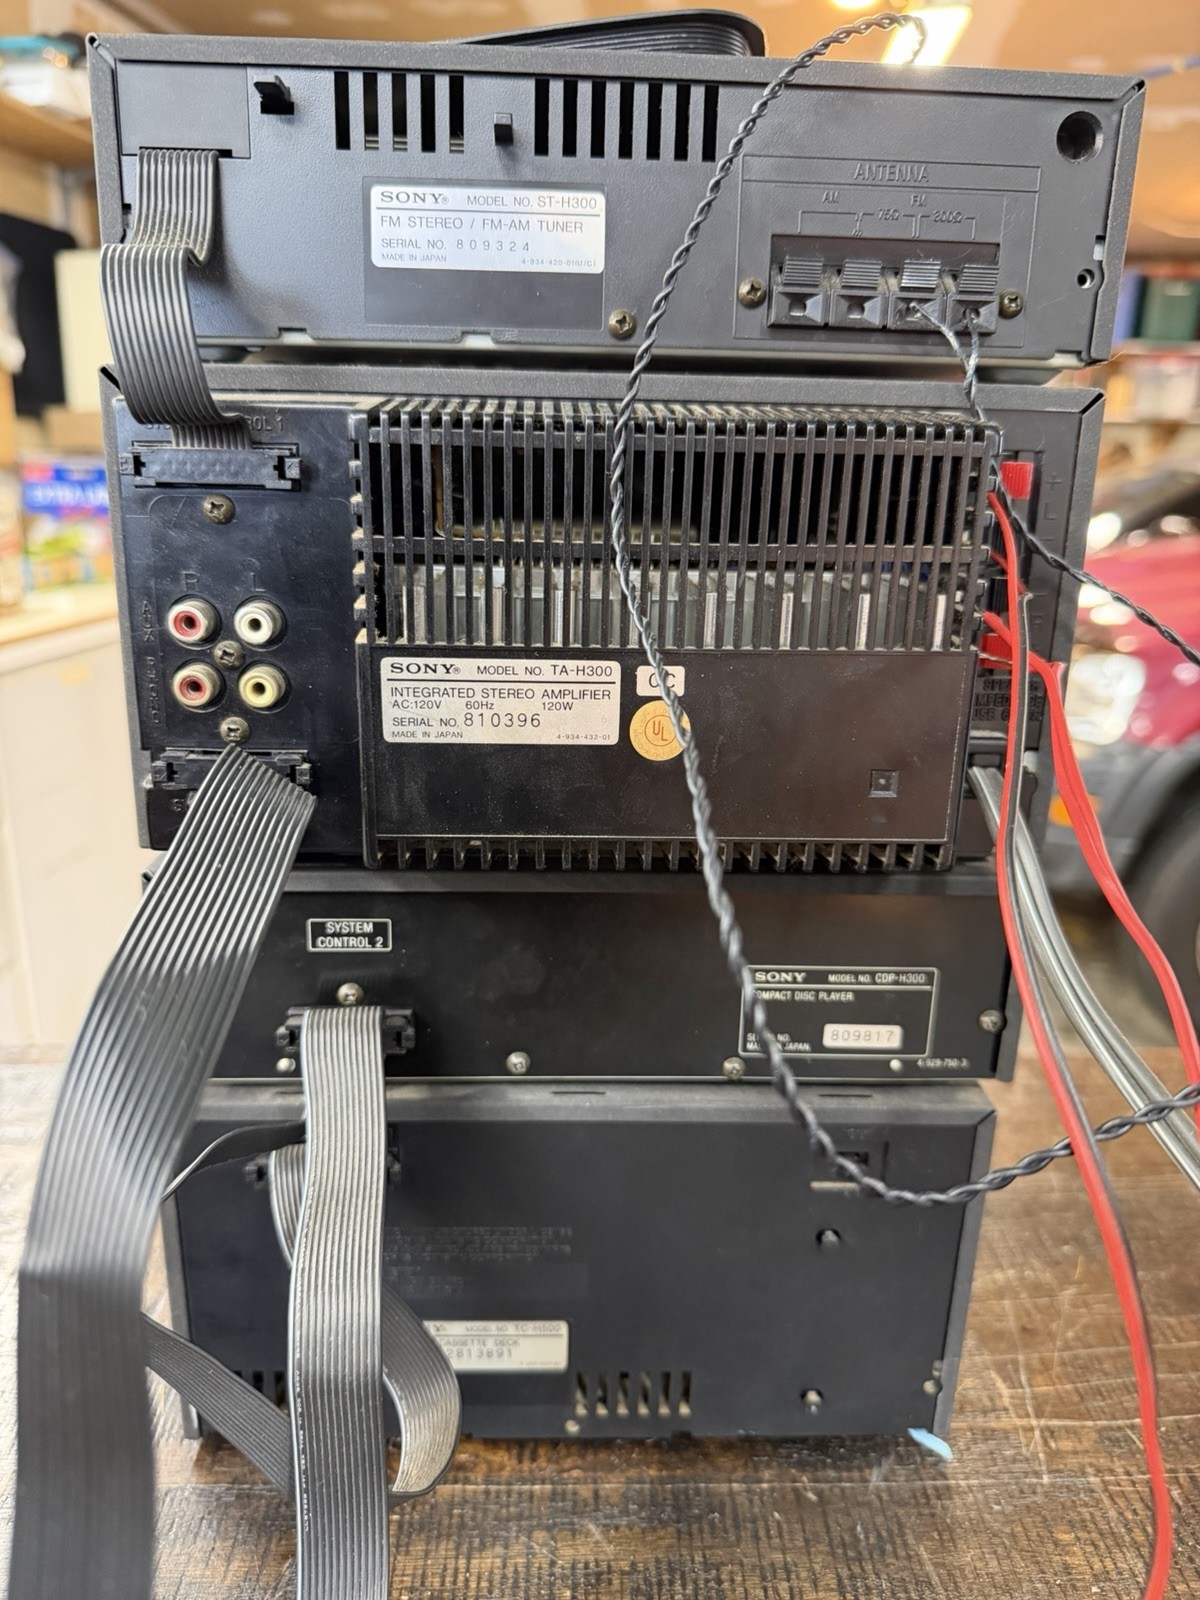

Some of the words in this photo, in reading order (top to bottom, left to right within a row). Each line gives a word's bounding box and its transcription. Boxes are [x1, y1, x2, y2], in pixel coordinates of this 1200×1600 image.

[853, 163, 929, 183] ANTENNA
[380, 190, 443, 205] SONY
[467, 195, 507, 207] MODEL
[514, 196, 533, 208] NO.
[538, 196, 597, 210] ST-H300
[822, 191, 840, 204] AM
[911, 194, 928, 207] FM
[381, 215, 401, 228] FM
[408, 216, 463, 230] STEREO
[483, 218, 530, 231] FM-AM
[537, 219, 583, 233] TUNER
[381, 238, 421, 249] SERIAL
[427, 239, 447, 250] NO.
[382, 253, 405, 262] MADE
[408, 254, 417, 262] IN
[420, 254, 447, 262] JAPAN
[390, 662, 455, 675] SONY
[477, 665, 518, 676] MODEL
[524, 666, 544, 676] NO.
[550, 664, 613, 677] TA-H300
[391, 686, 476, 698] INTEGRATED
[481, 687, 535, 699] STEREO
[541, 688, 611, 700] AMPLIFIER
[392, 699, 442, 709] AC:120V
[465, 700, 495, 710] 60Hz
[542, 701, 574, 711] 120W
[392, 717, 434, 727] SERIAL
[440, 717, 460, 728] NO.
[464, 712, 541, 728] 810396
[392, 731, 418, 739] MADE
[422, 731, 431, 739] IN
[434, 731, 463, 739] JAPAN
[325, 921, 374, 935] SYSTEM
[315, 936, 373, 949] CONTROL
[375, 936, 384, 948] 2
[755, 971, 807, 983] SONY
[828, 973, 857, 984] MODEL
[874, 972, 928, 984] CDP-H300
[794, 990, 816, 1001] DISC
[818, 991, 855, 1002] PLAYER
[830, 1029, 895, 1042] 809817
[784, 1043, 811, 1052] JAPAN
